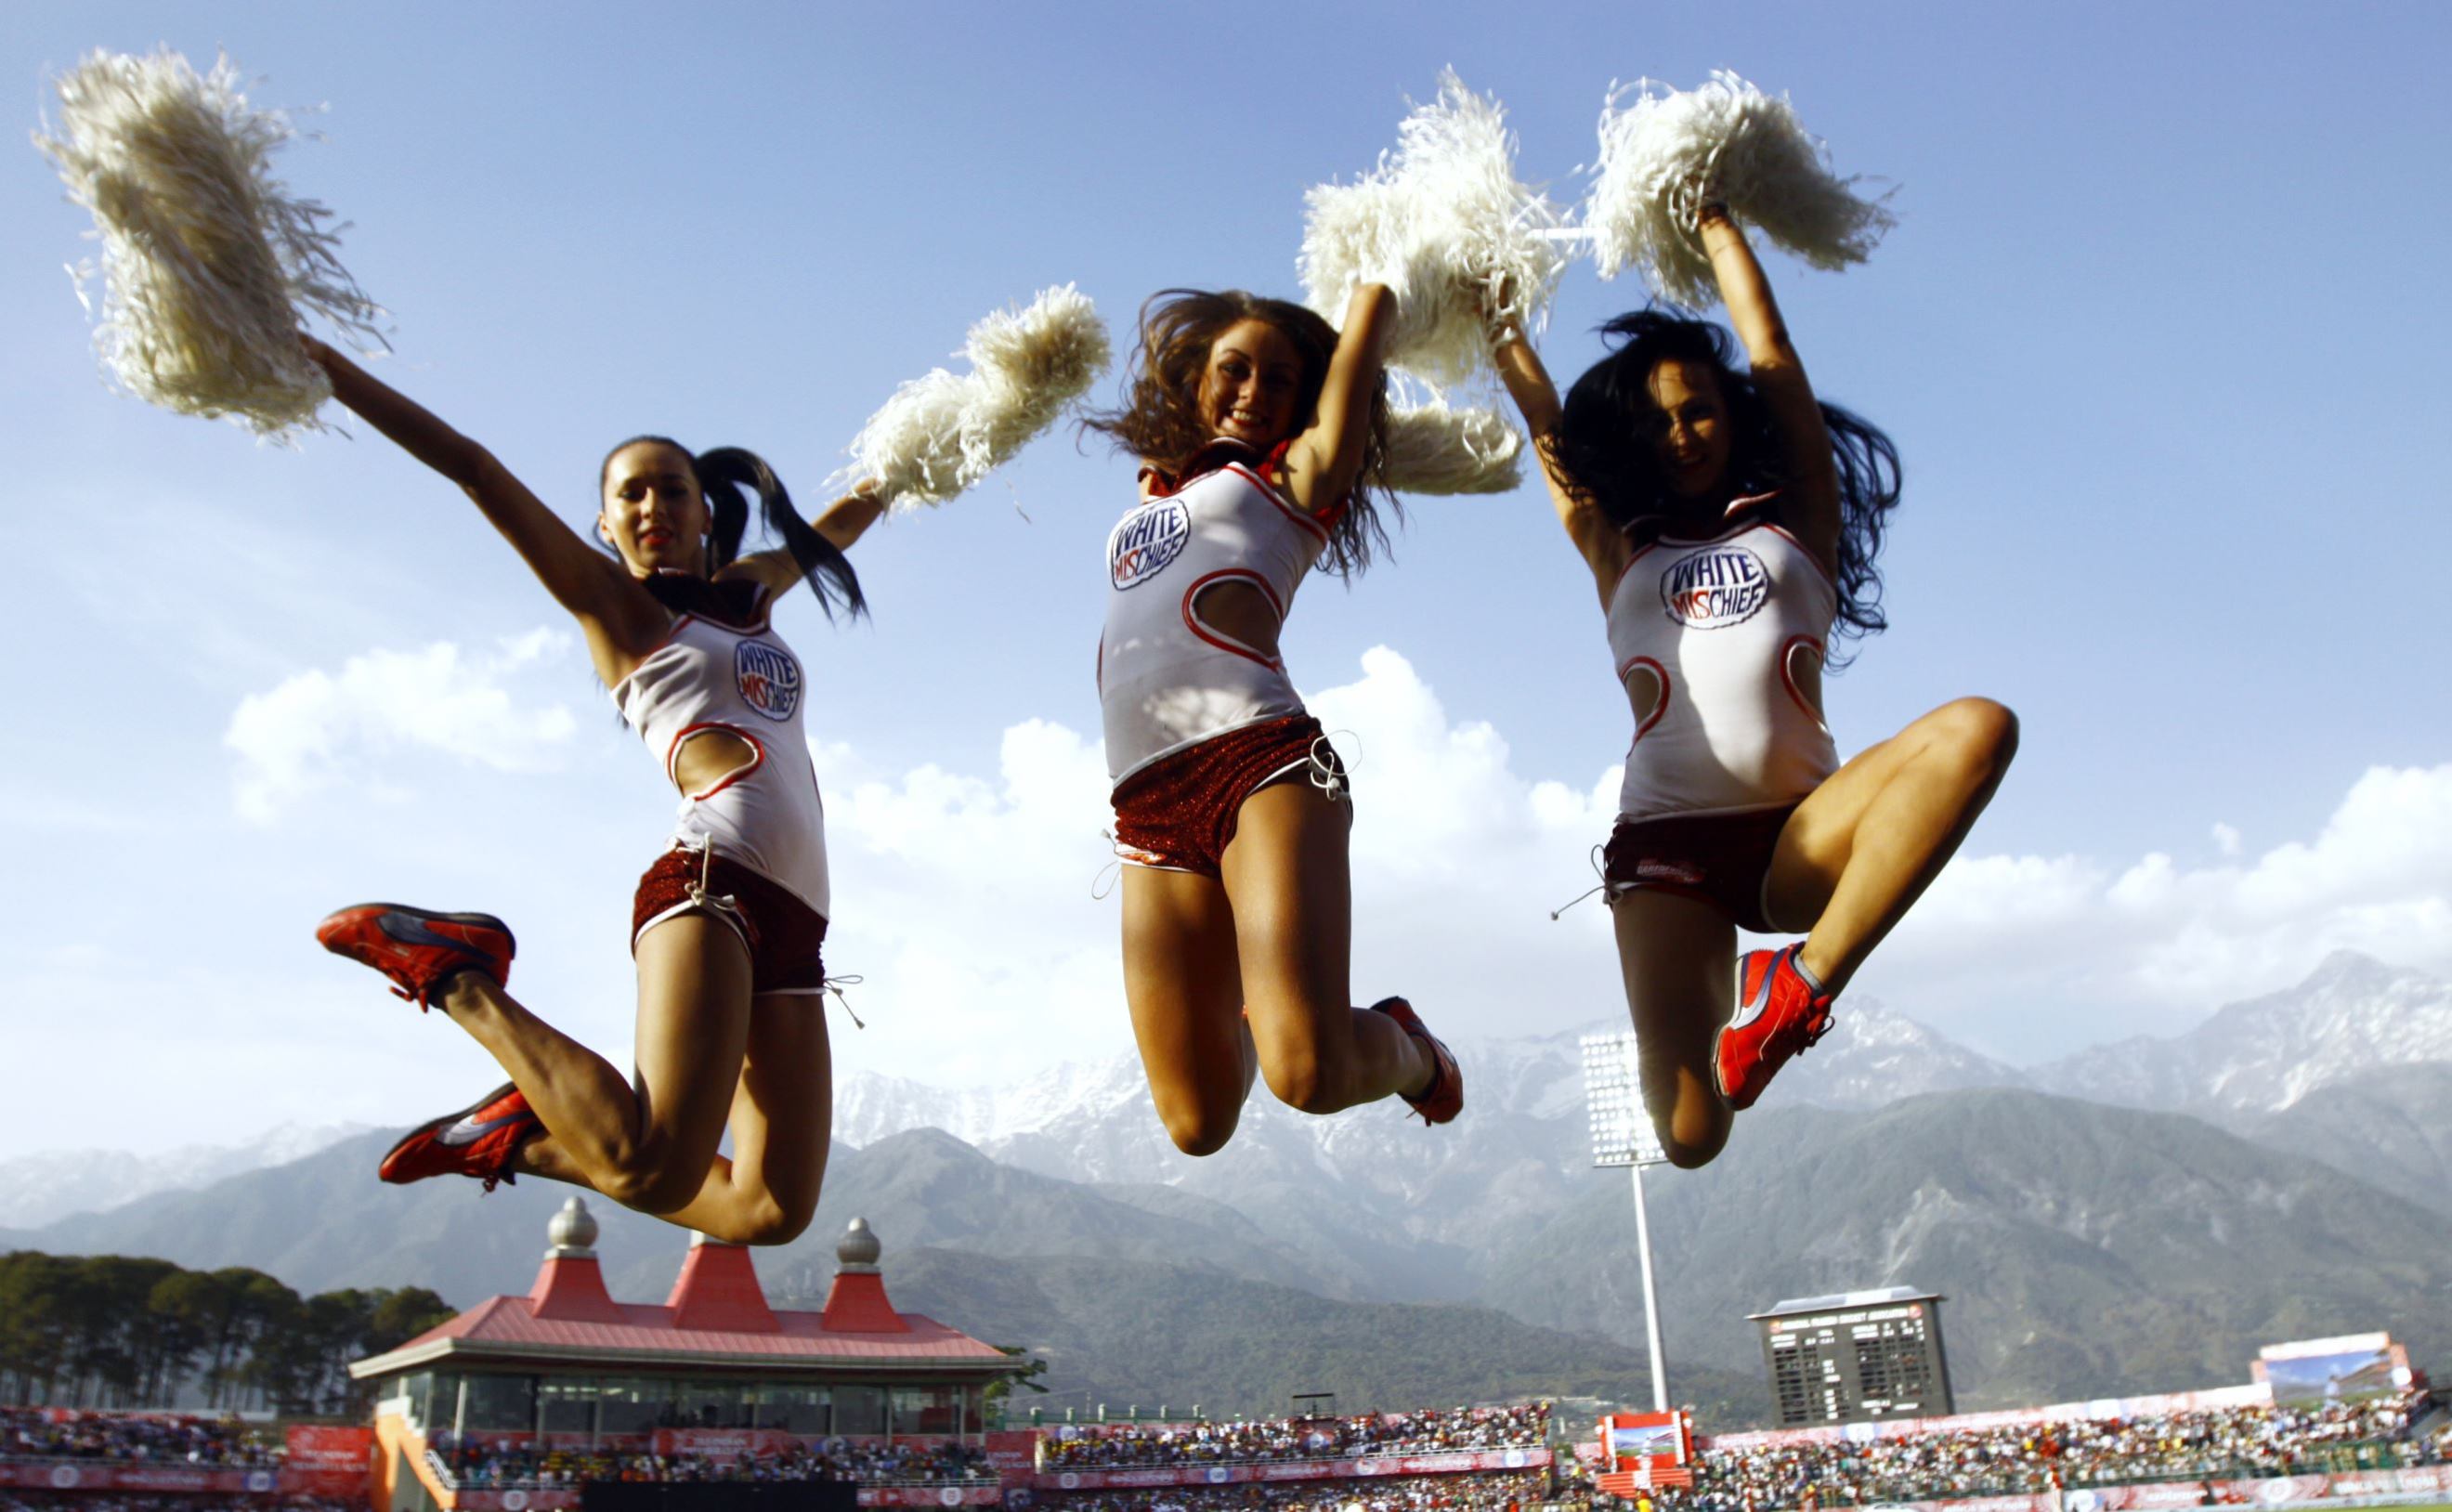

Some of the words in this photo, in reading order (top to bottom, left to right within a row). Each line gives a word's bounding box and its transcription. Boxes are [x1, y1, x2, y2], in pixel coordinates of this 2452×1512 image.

[1115, 507, 1183, 559] WHITE
[1115, 528, 1186, 581] MISCHIEF
[1672, 554, 1760, 594] WHITE
[1672, 580, 1764, 620] MISCHIEF
[741, 645, 797, 684] WHITE
[741, 675, 798, 712] MISCHIEF
